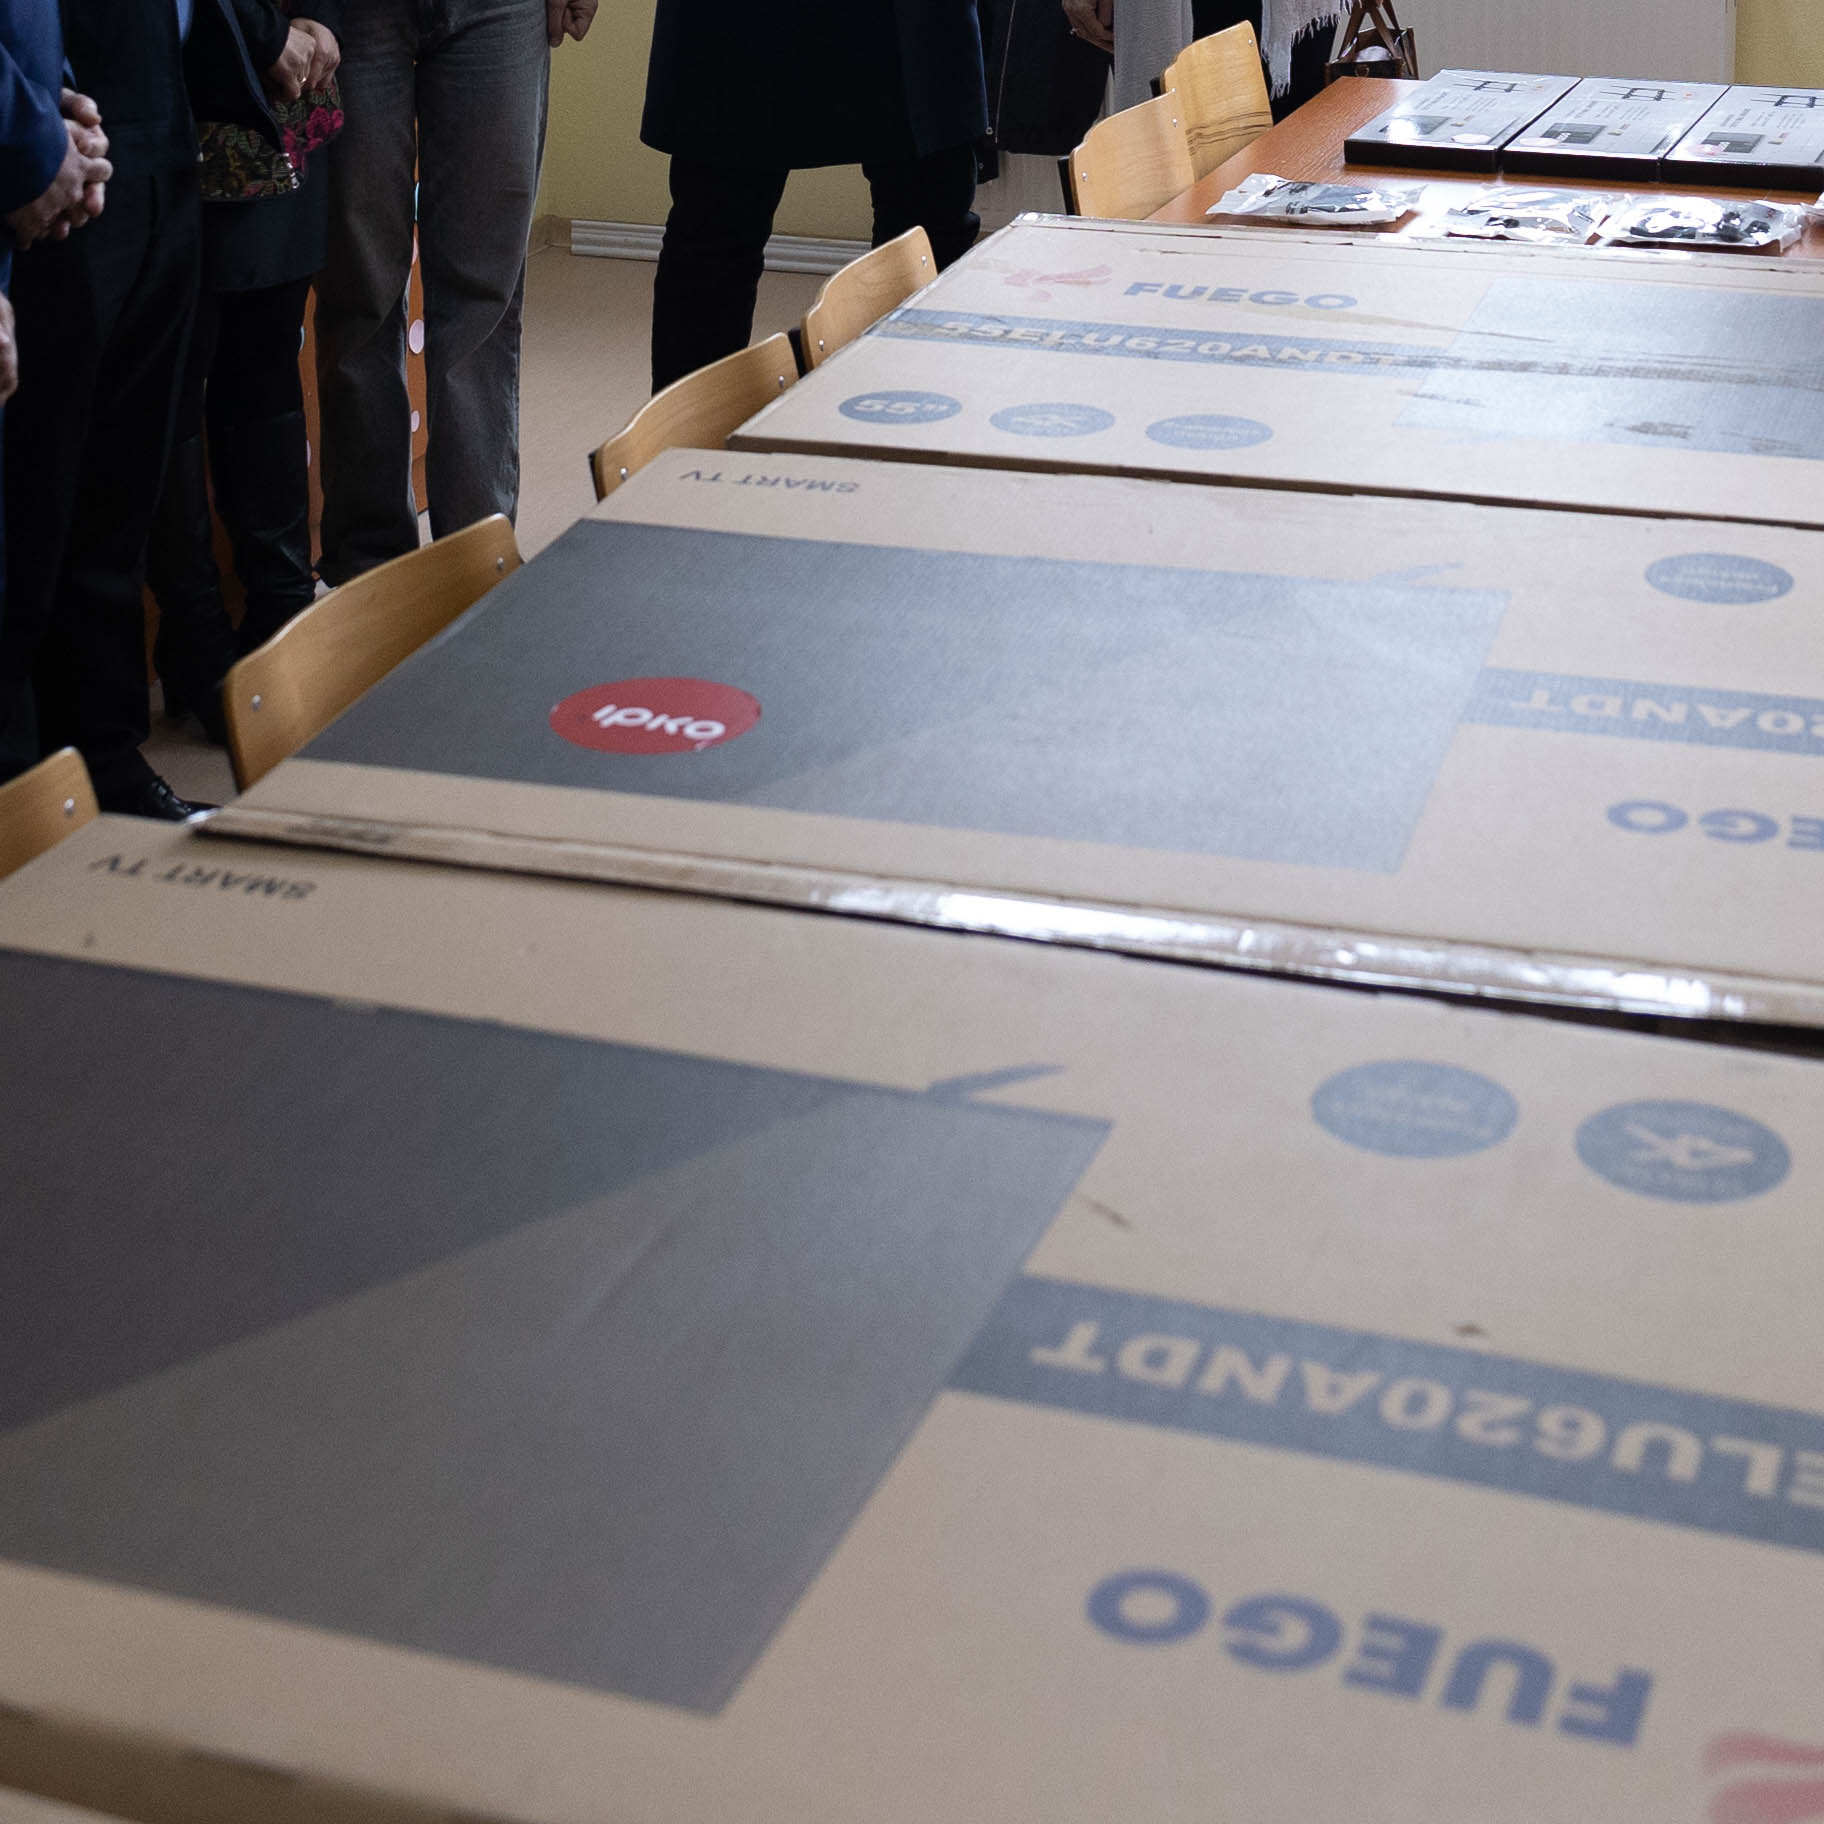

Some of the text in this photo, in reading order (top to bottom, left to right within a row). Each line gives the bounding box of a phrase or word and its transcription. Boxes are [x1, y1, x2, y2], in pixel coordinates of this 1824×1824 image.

[1123, 281, 1358, 310] FUEGO
[90, 853, 317, 900] SMART TV
[1085, 1569, 1654, 1748] FUEGO
